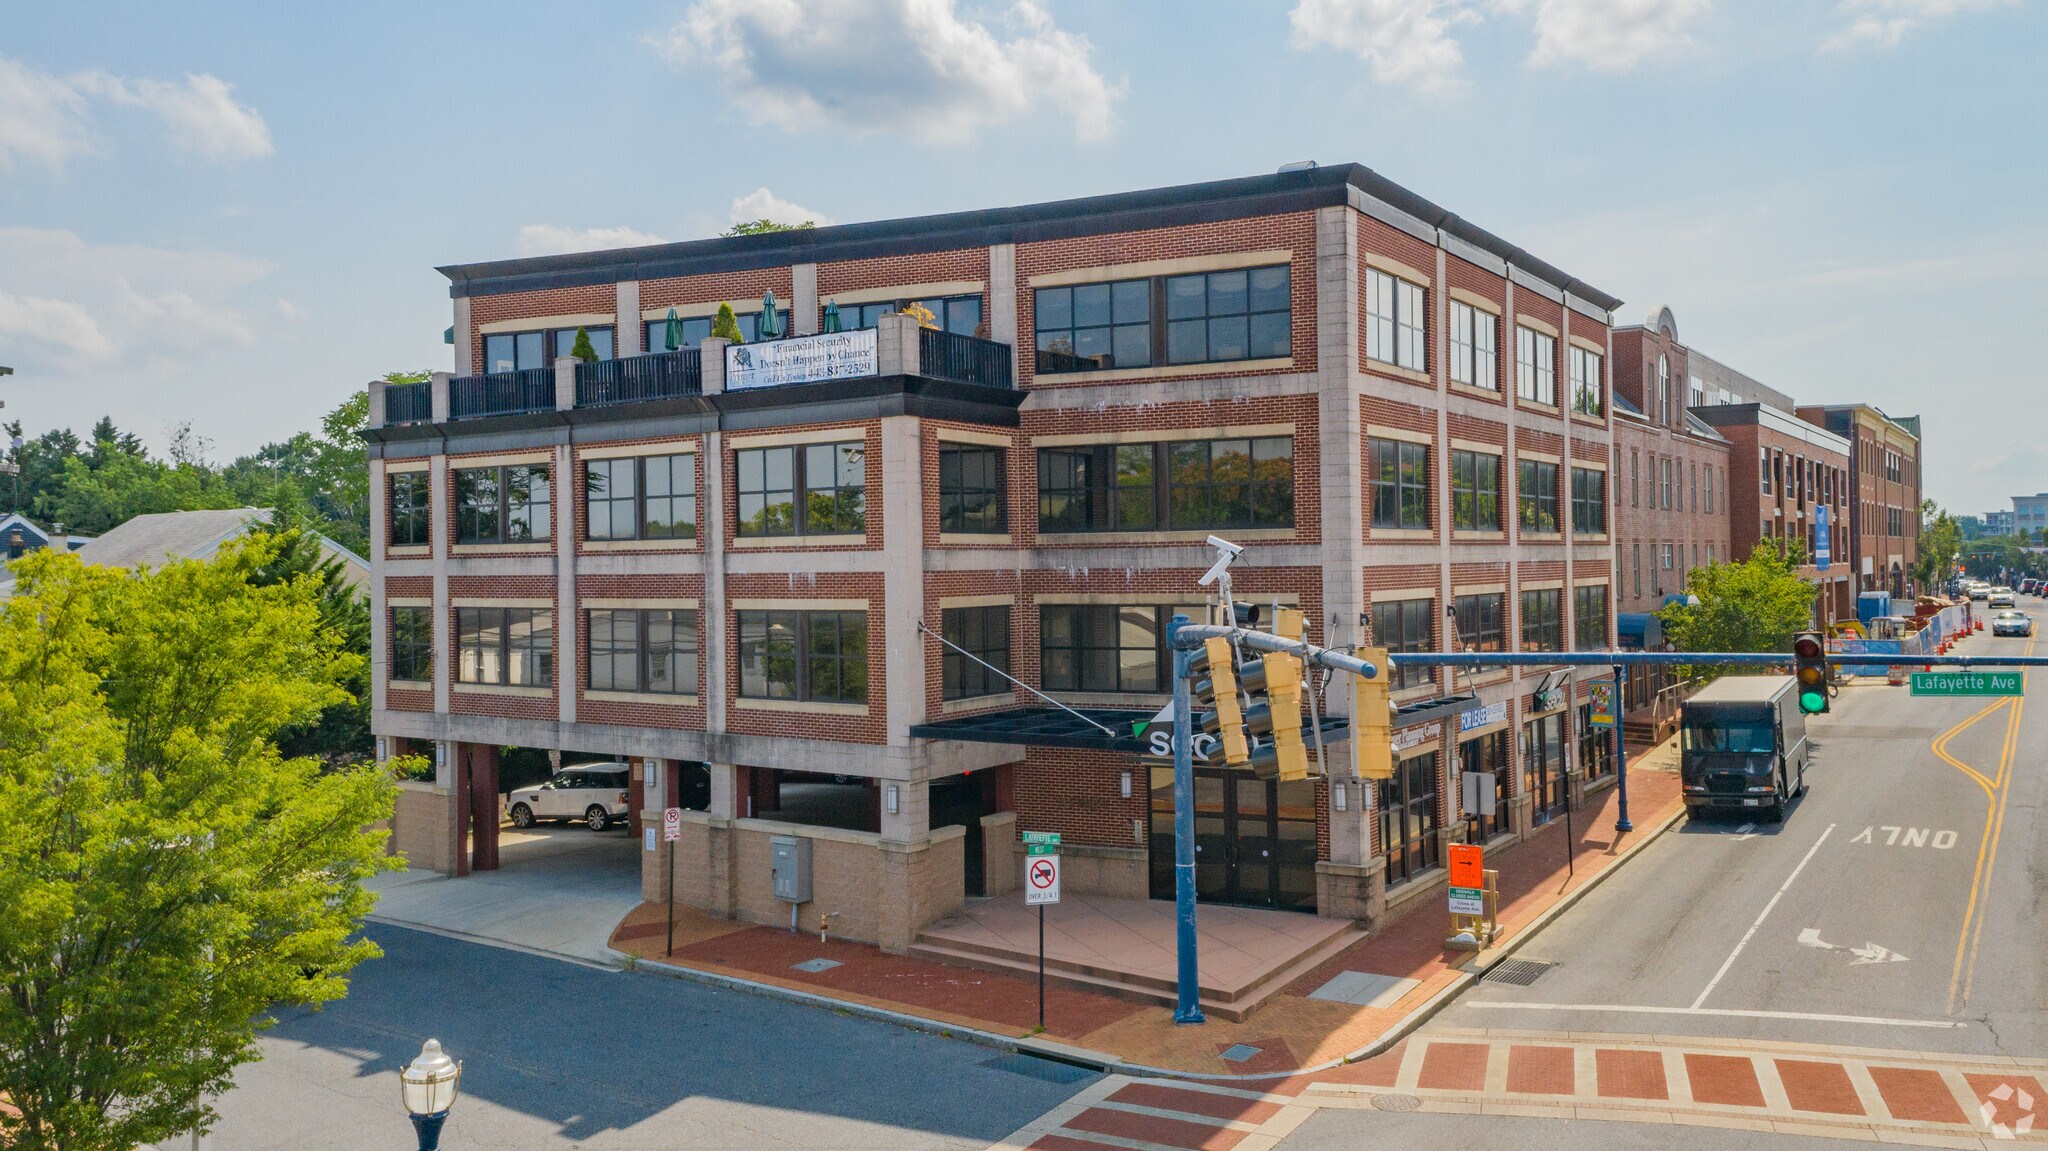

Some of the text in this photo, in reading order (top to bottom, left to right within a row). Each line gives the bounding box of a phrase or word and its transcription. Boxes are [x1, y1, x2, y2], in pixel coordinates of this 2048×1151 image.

[817, 336, 851, 349] Security
[761, 357, 791, 369] Doesn't
[793, 353, 825, 367] Happen
[827, 352, 836, 363] by
[808, 362, 870, 379] 443-837-2529
[1917, 675, 2015, 692] Lafayette Ave
[1461, 712, 1471, 730] FOR
[1472, 708, 1486, 727] LEASE
[1425, 722, 1440, 738] Group
[1850, 825, 1959, 849] ONLY
[1043, 892, 1053, 900] 3/4
